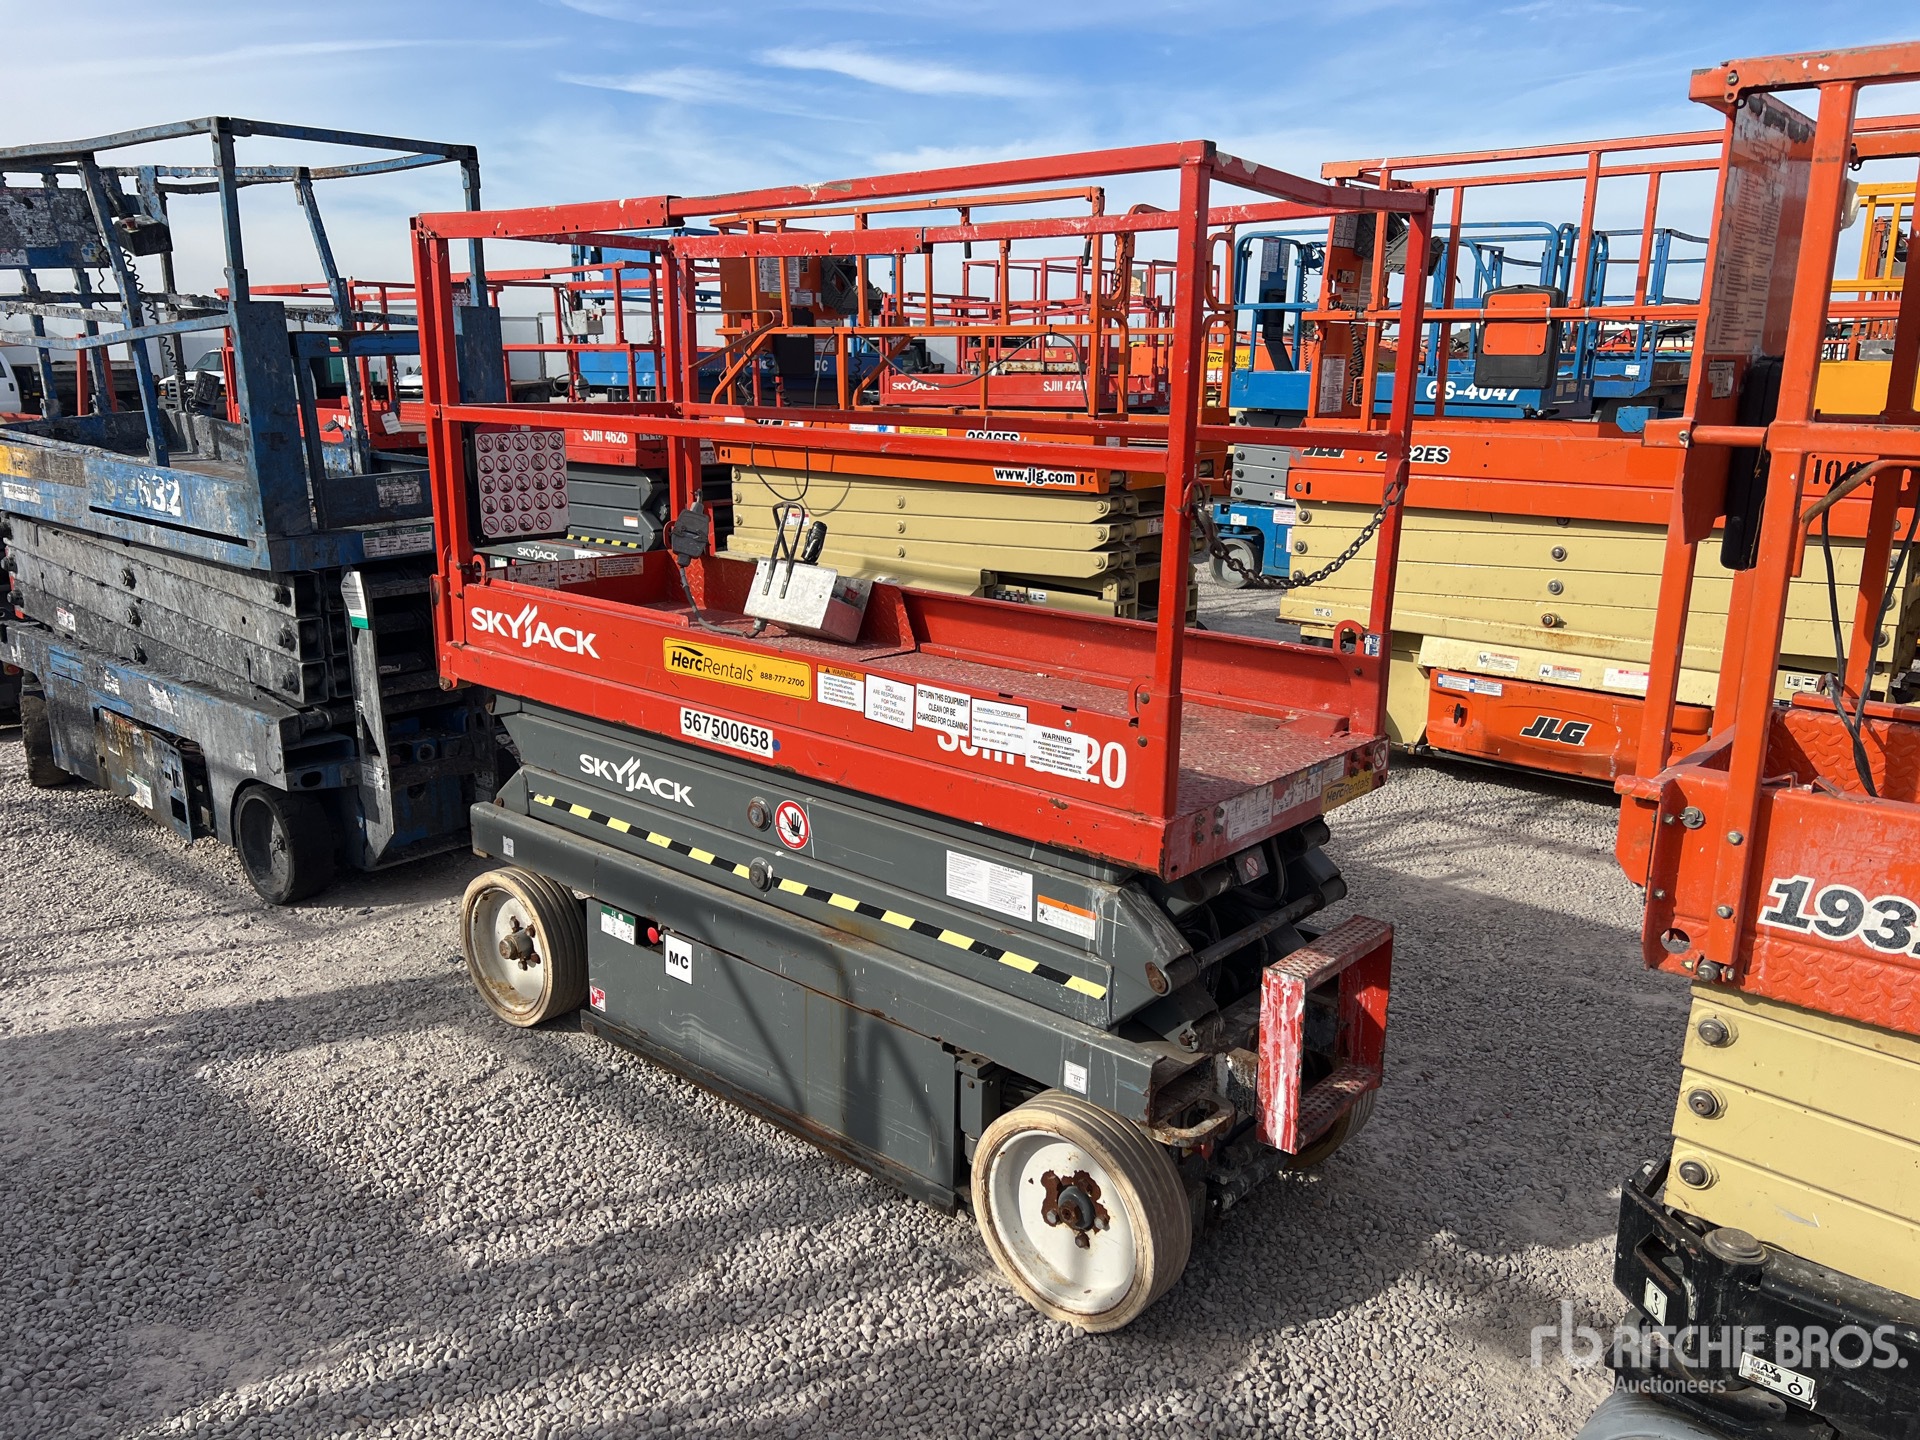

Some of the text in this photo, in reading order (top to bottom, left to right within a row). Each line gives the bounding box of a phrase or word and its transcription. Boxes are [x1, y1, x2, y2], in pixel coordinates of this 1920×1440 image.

[994, 467, 1075, 485] www.jlg.com
[517, 545, 559, 561] SKYJACK
[470, 603, 600, 659] SKYJACK
[918, 689, 968, 707] RETURN THIS EQUIPMENT
[928, 703, 956, 716] CLEAN OR BE
[684, 710, 769, 750] 567500658
[917, 712, 968, 731] CHARGED FOR CLEANING
[1520, 715, 1592, 746] JLG
[1042, 732, 1071, 743] WARNING
[579, 753, 695, 808] SKYJACK
[669, 950, 689, 970] MC
[1749, 1359, 1778, 1376] MAX
